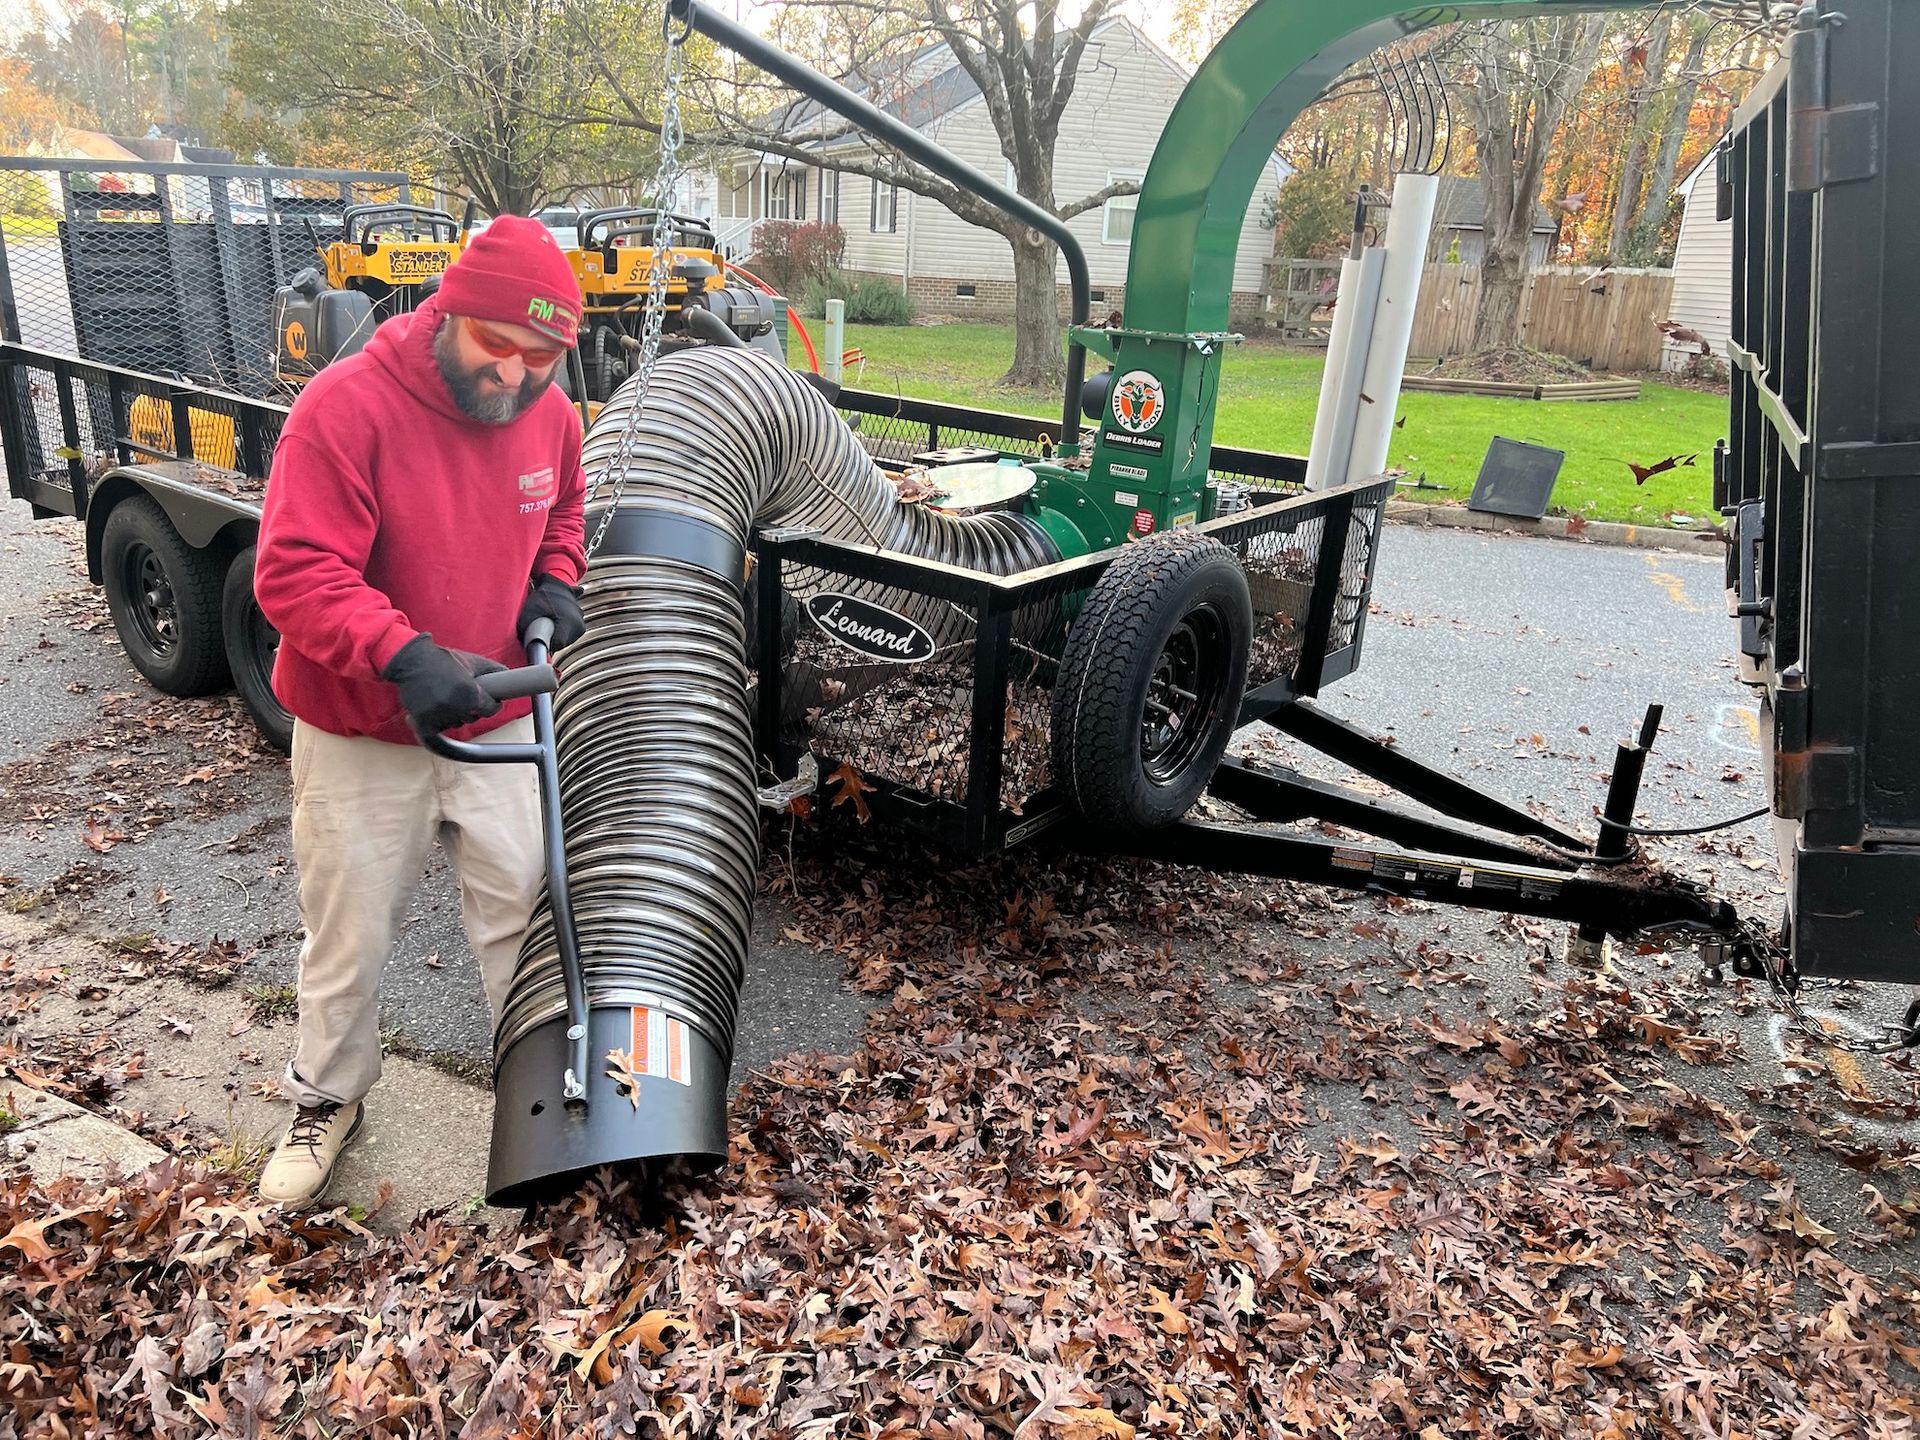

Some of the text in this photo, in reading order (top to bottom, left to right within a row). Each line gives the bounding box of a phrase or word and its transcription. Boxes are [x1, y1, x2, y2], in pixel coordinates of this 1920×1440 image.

[528, 298, 554, 321] FM
[292, 332, 305, 350] W
[1114, 395, 1162, 430] BILLY GOAT
[1132, 437, 1162, 449] LOADER
[818, 600, 917, 654] Leonard
